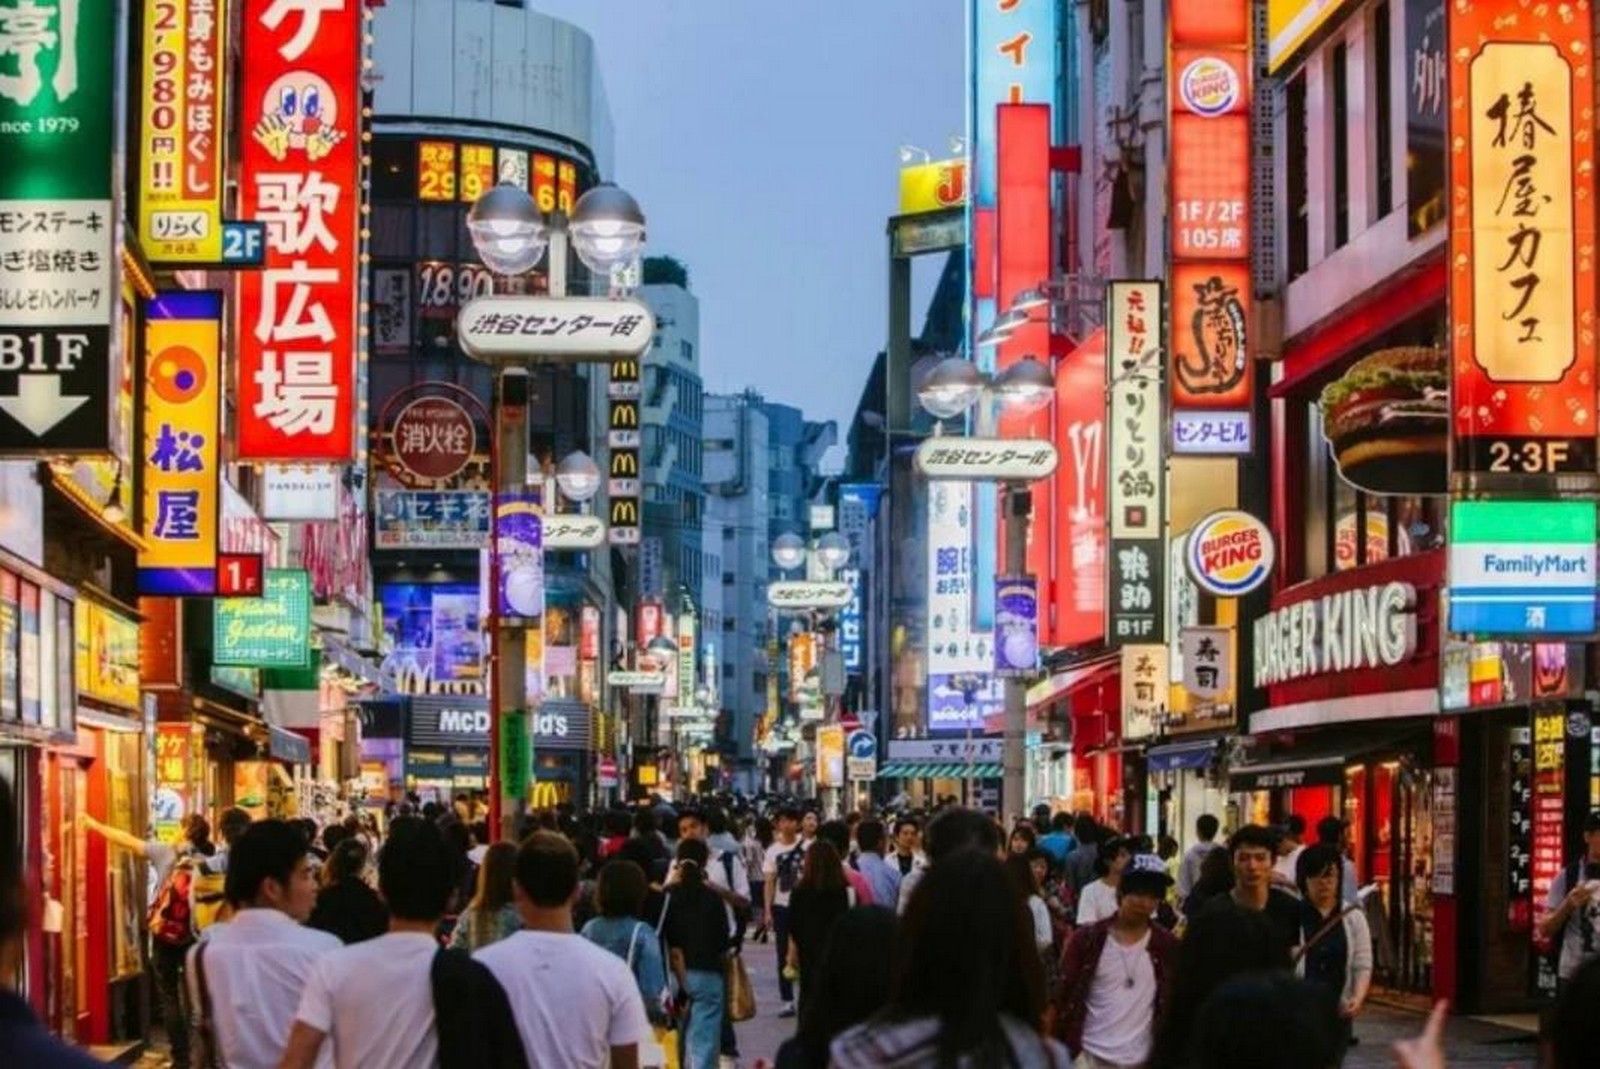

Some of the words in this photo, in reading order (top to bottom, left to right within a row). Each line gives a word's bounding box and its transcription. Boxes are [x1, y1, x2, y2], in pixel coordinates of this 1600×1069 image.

[38, 117, 79, 133] 1979
[157, 216, 203, 237] りらく
[1485, 81, 1558, 343] 椿屋カフェ
[223, 228, 261, 258] 2F
[0, 249, 100, 273] ぎ塩焼き
[254, 171, 340, 437] 歌広場
[468, 312, 645, 338] 渋谷センター街
[400, 423, 470, 455] 消火栓
[1176, 421, 1247, 443] センタービル
[150, 423, 205, 540] 松屋
[1201, 528, 1259, 557] BURGER
[1201, 541, 1262, 575] KING
[1484, 553, 1587, 578] FamilyMart
[1116, 619, 1154, 637] B1F
[1322, 581, 1412, 668] KING
[1525, 605, 1546, 629] 酒
[1195, 635, 1220, 690] 寿司
